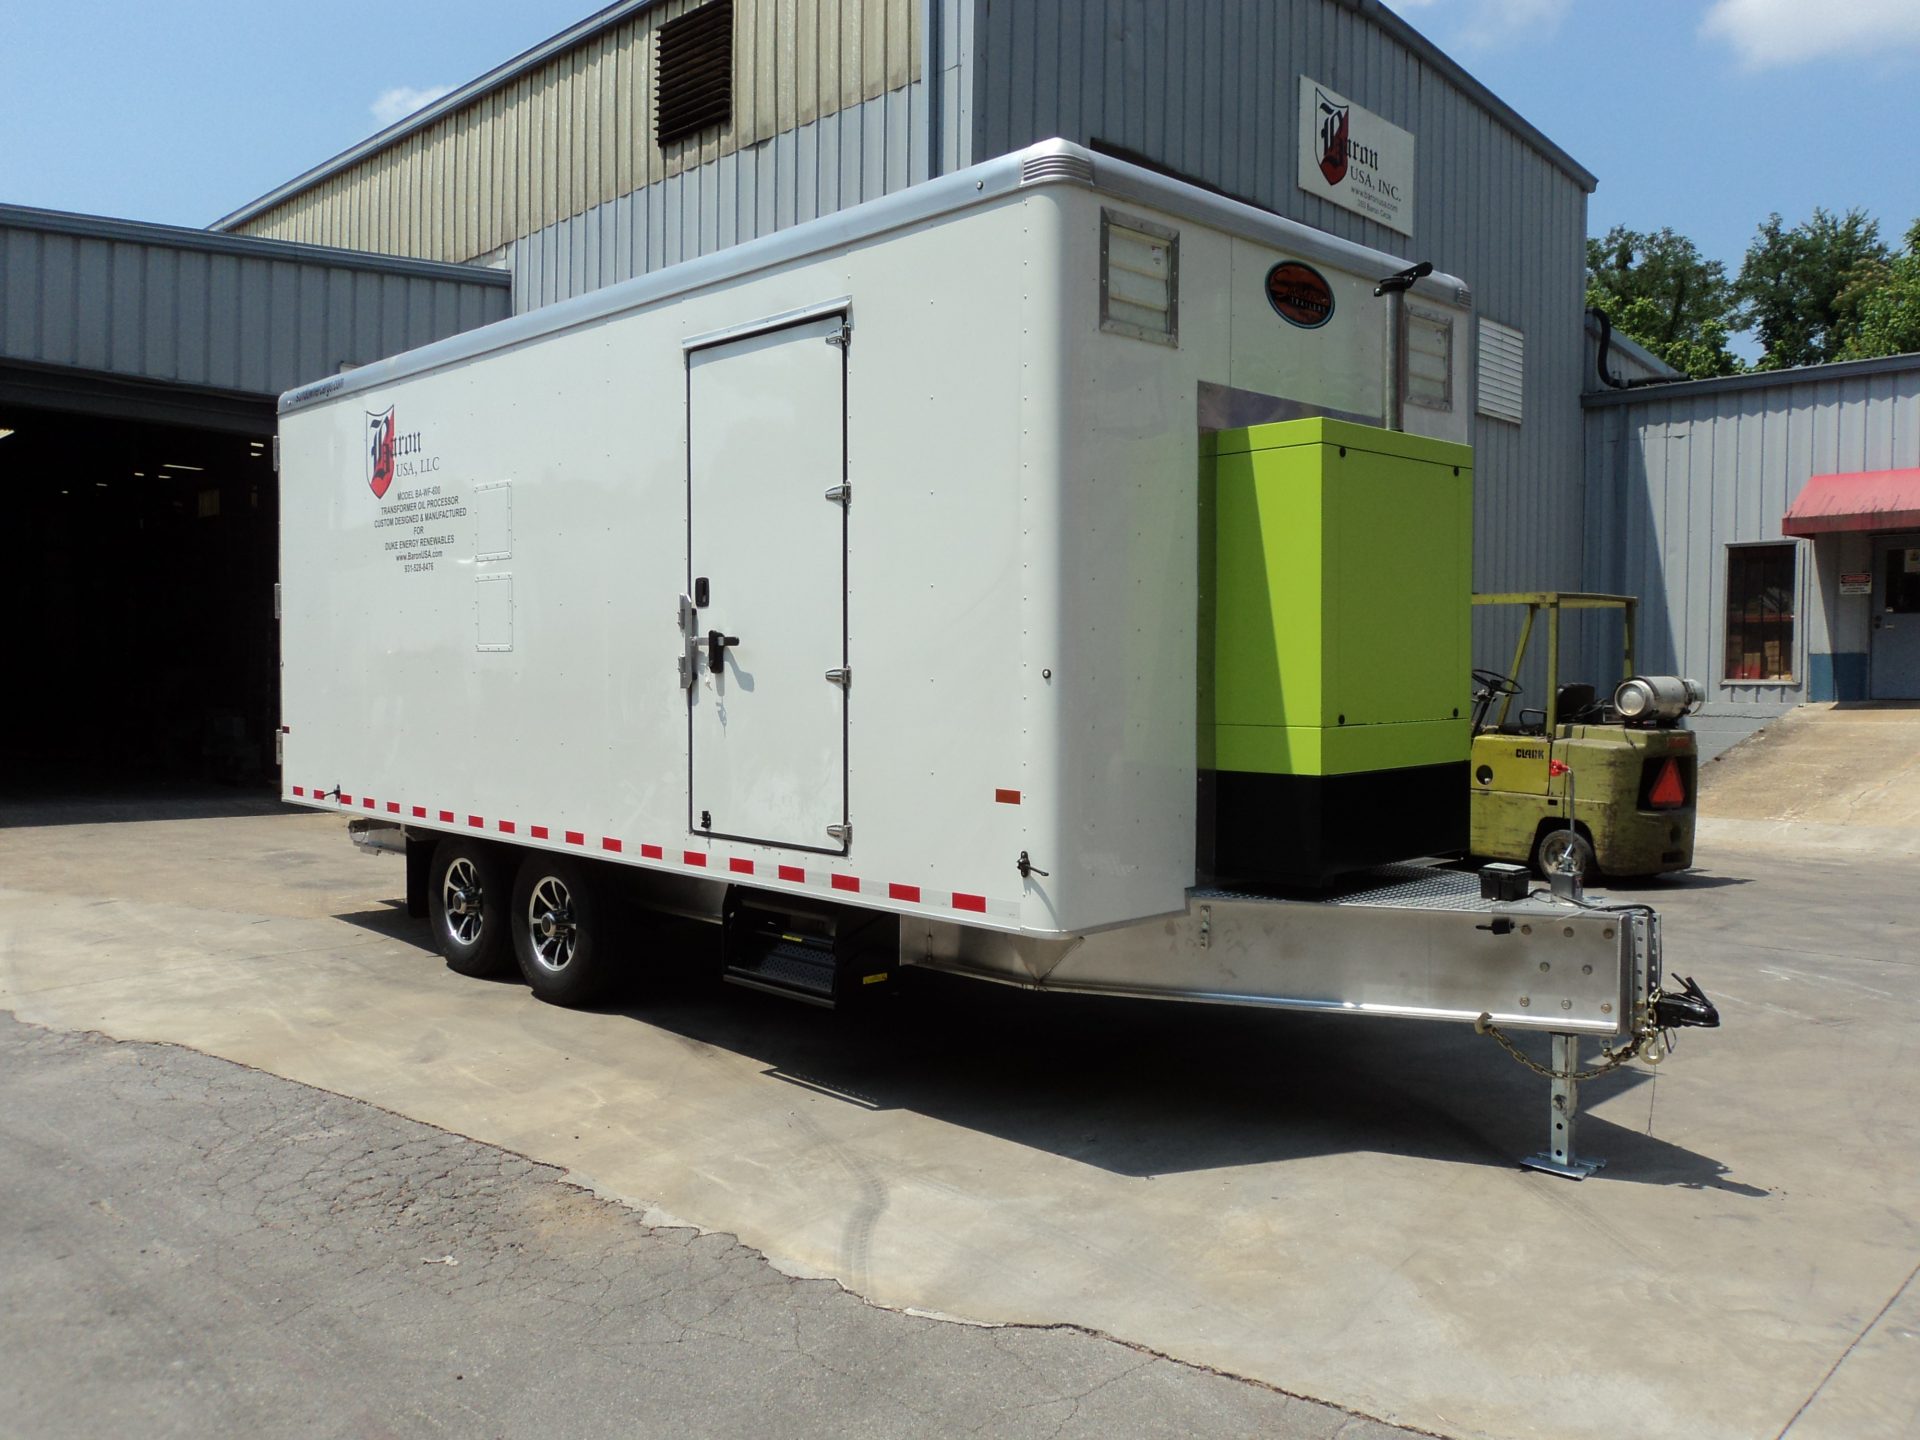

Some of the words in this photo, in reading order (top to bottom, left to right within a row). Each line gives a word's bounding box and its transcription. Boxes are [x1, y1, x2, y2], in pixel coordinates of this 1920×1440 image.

[1320, 103, 1379, 171] Baron
[1350, 168, 1375, 191] USA,
[1378, 179, 1402, 201] INC.
[370, 415, 421, 480] Baron
[396, 461, 418, 477] USA,
[420, 457, 440, 473] LLC
[381, 502, 417, 515] TRANSFORMER
[417, 501, 426, 510] OIL
[426, 495, 459, 509] PROCESSOR
[397, 490, 414, 500] MODEL
[374, 518, 394, 528] CUSTOM
[394, 514, 419, 526] DESIGNED
[420, 513, 424, 522] &
[424, 507, 467, 521] MANUFACTURED
[413, 526, 424, 535] FOR
[385, 541, 398, 550] DUKE
[399, 538, 418, 549] ENERGY
[419, 534, 454, 547] RENEWABLES
[396, 550, 443, 561] www.BaronUSA.com
[1515, 748, 1545, 760] CLARK
